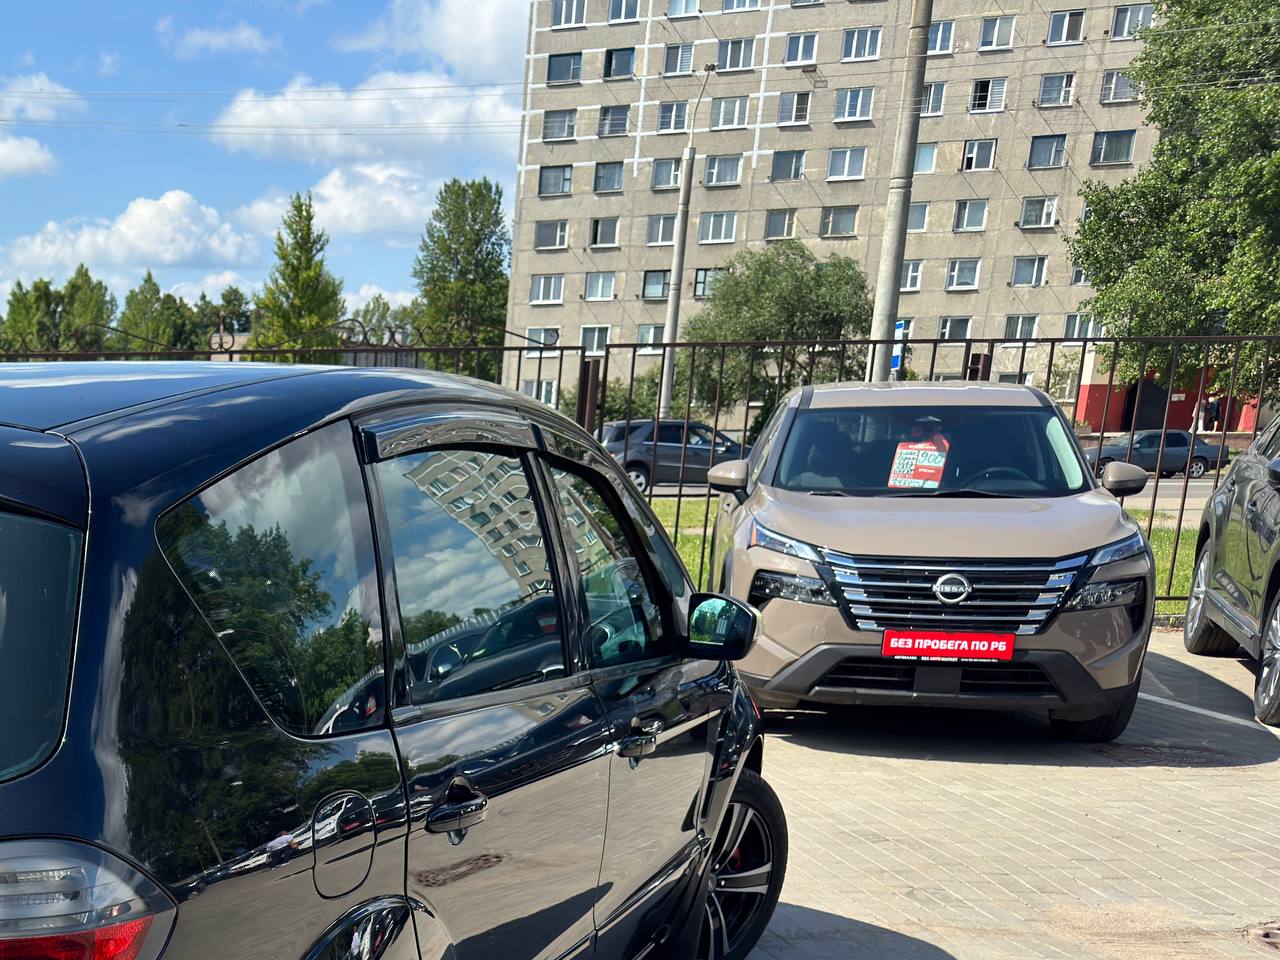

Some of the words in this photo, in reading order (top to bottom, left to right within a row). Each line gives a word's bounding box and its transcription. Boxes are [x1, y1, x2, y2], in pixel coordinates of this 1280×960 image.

[932, 584, 972, 593] NISSAN
[890, 637, 912, 649] БЕЗ
[914, 639, 969, 651] ПРОБЕГА
[970, 641, 989, 651] ПО
[990, 641, 1007, 652] РБ
